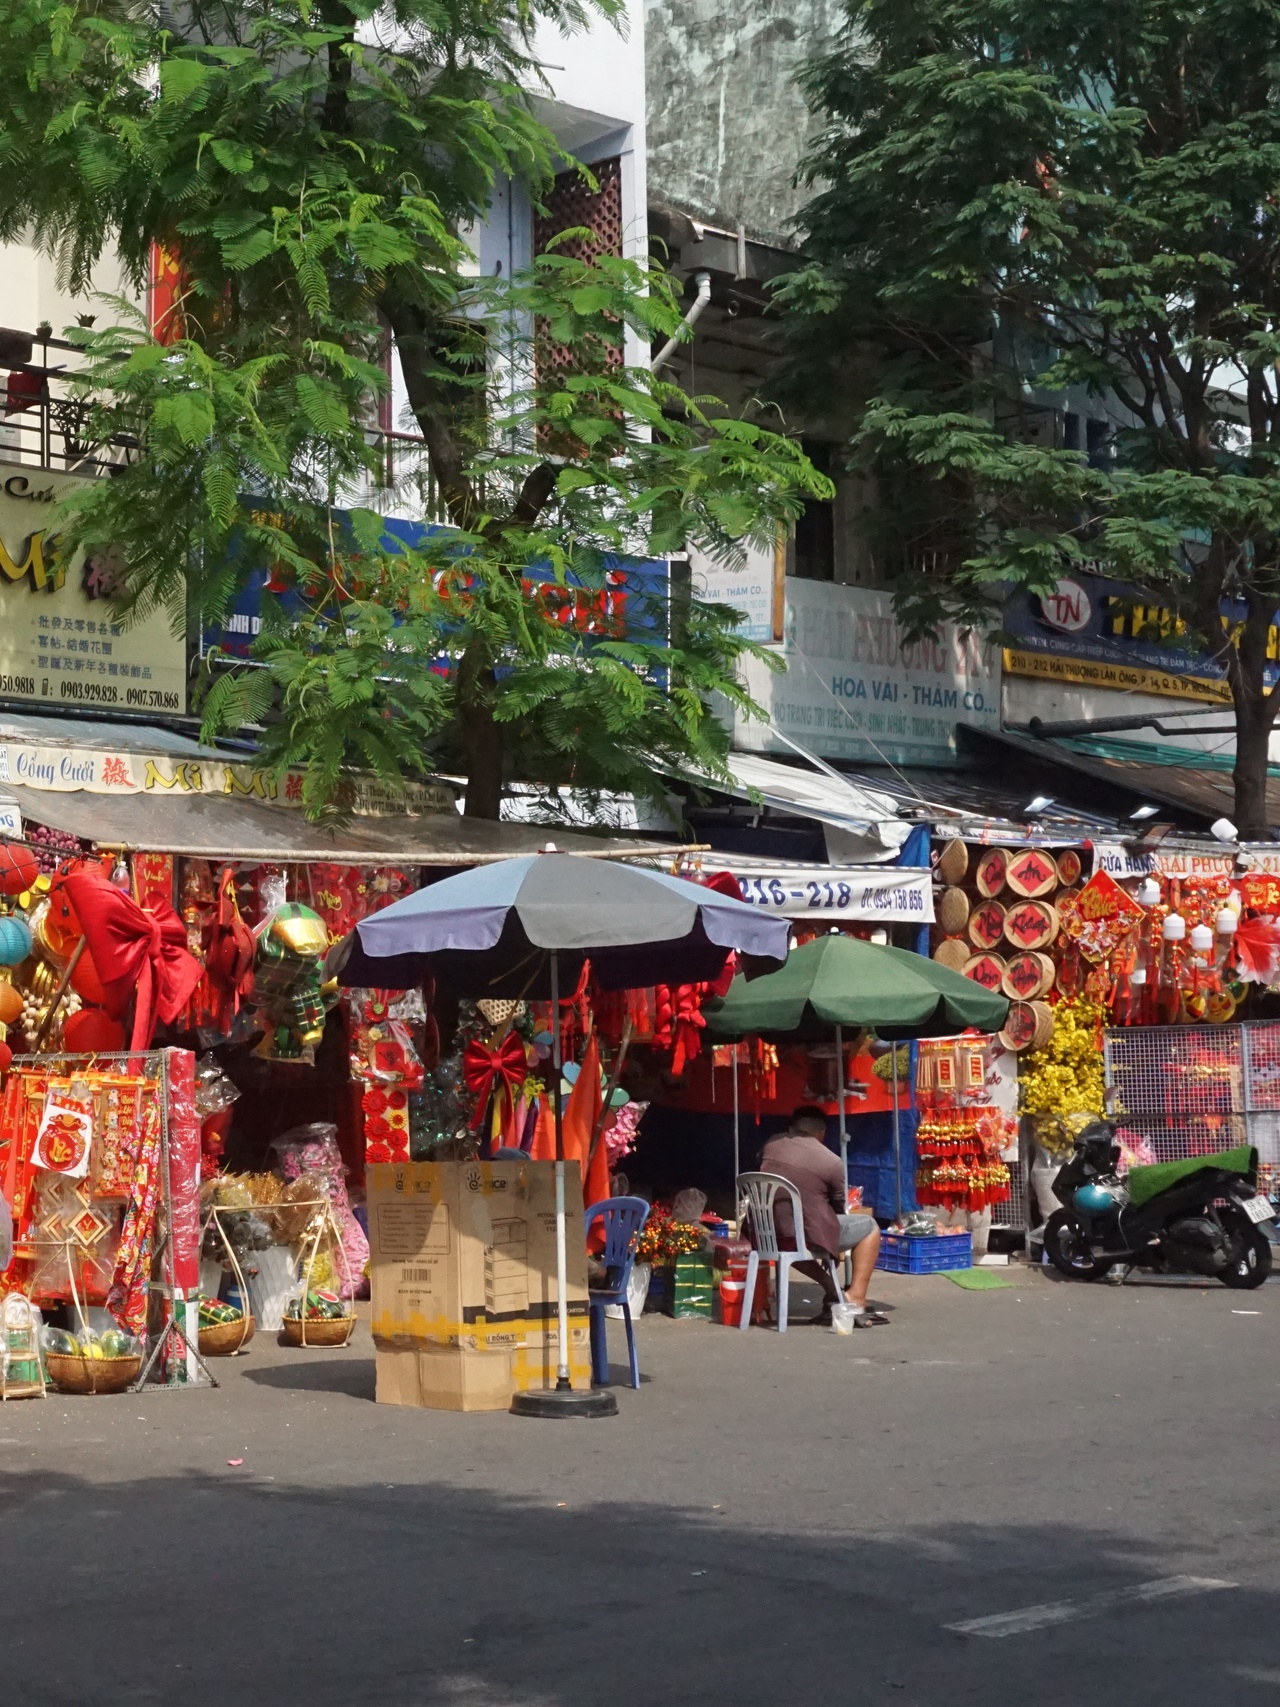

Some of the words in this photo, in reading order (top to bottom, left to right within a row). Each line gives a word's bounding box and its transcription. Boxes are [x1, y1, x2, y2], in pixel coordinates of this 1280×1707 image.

[1034, 658, 1048, 672] 212
[1050, 658, 1064, 673] HẢI
[60, 681, 118, 703] 0903.929.828
[126, 687, 179, 709] 0907.570.868
[832, 676, 867, 699] HOA
[912, 682, 957, 709] THẢM
[17, 752, 55, 785] Cổng
[61, 756, 95, 782] Cưới
[144, 759, 203, 792] Mi
[223, 766, 279, 801] Mi
[1099, 851, 1121, 873] CỬA
[737, 876, 853, 909] 216-218
